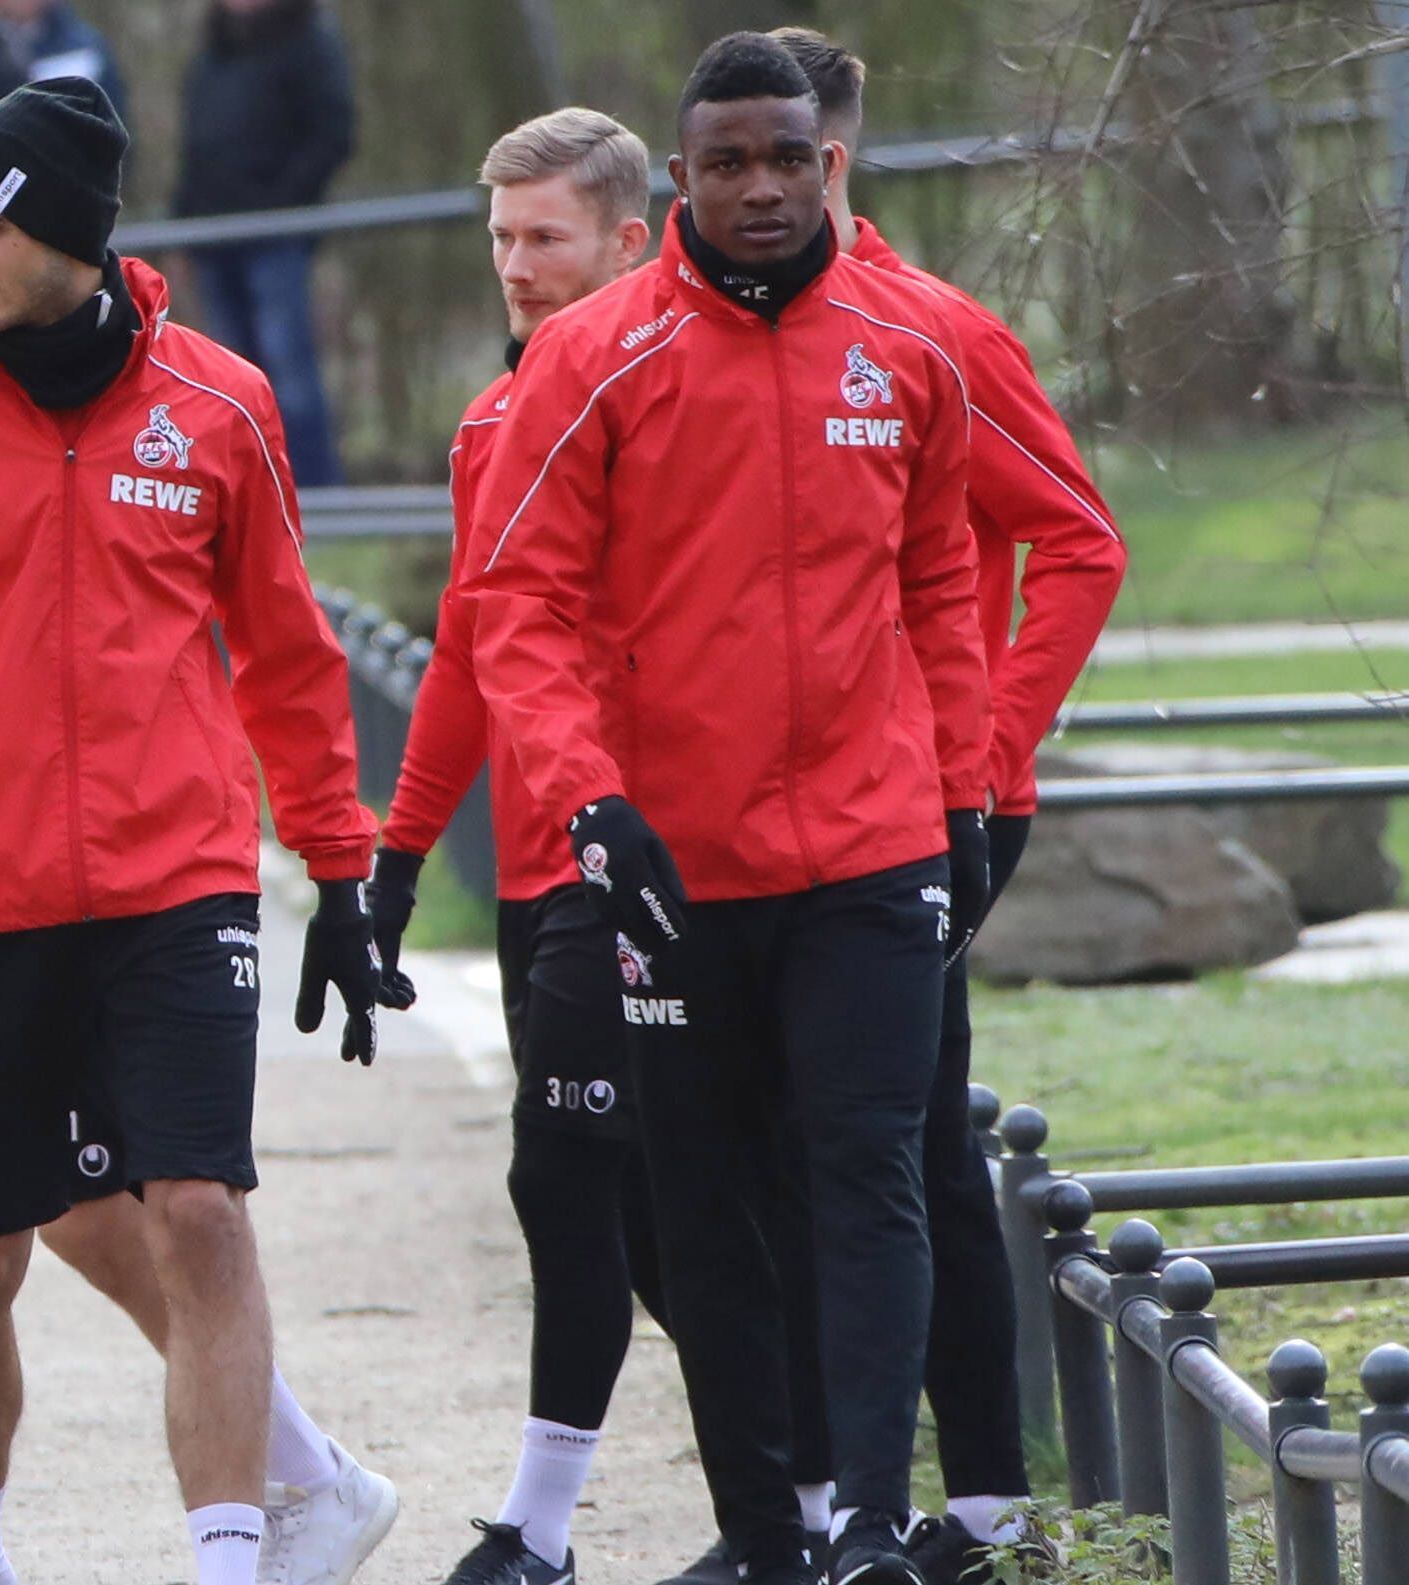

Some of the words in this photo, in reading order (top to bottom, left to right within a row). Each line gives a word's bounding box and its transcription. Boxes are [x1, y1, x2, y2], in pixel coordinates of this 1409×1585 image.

[825, 417, 904, 448] REWE
[110, 473, 203, 516] REWE
[639, 887, 679, 941] uhlsport
[230, 955, 256, 989] 28
[546, 1077, 580, 1110] 30
